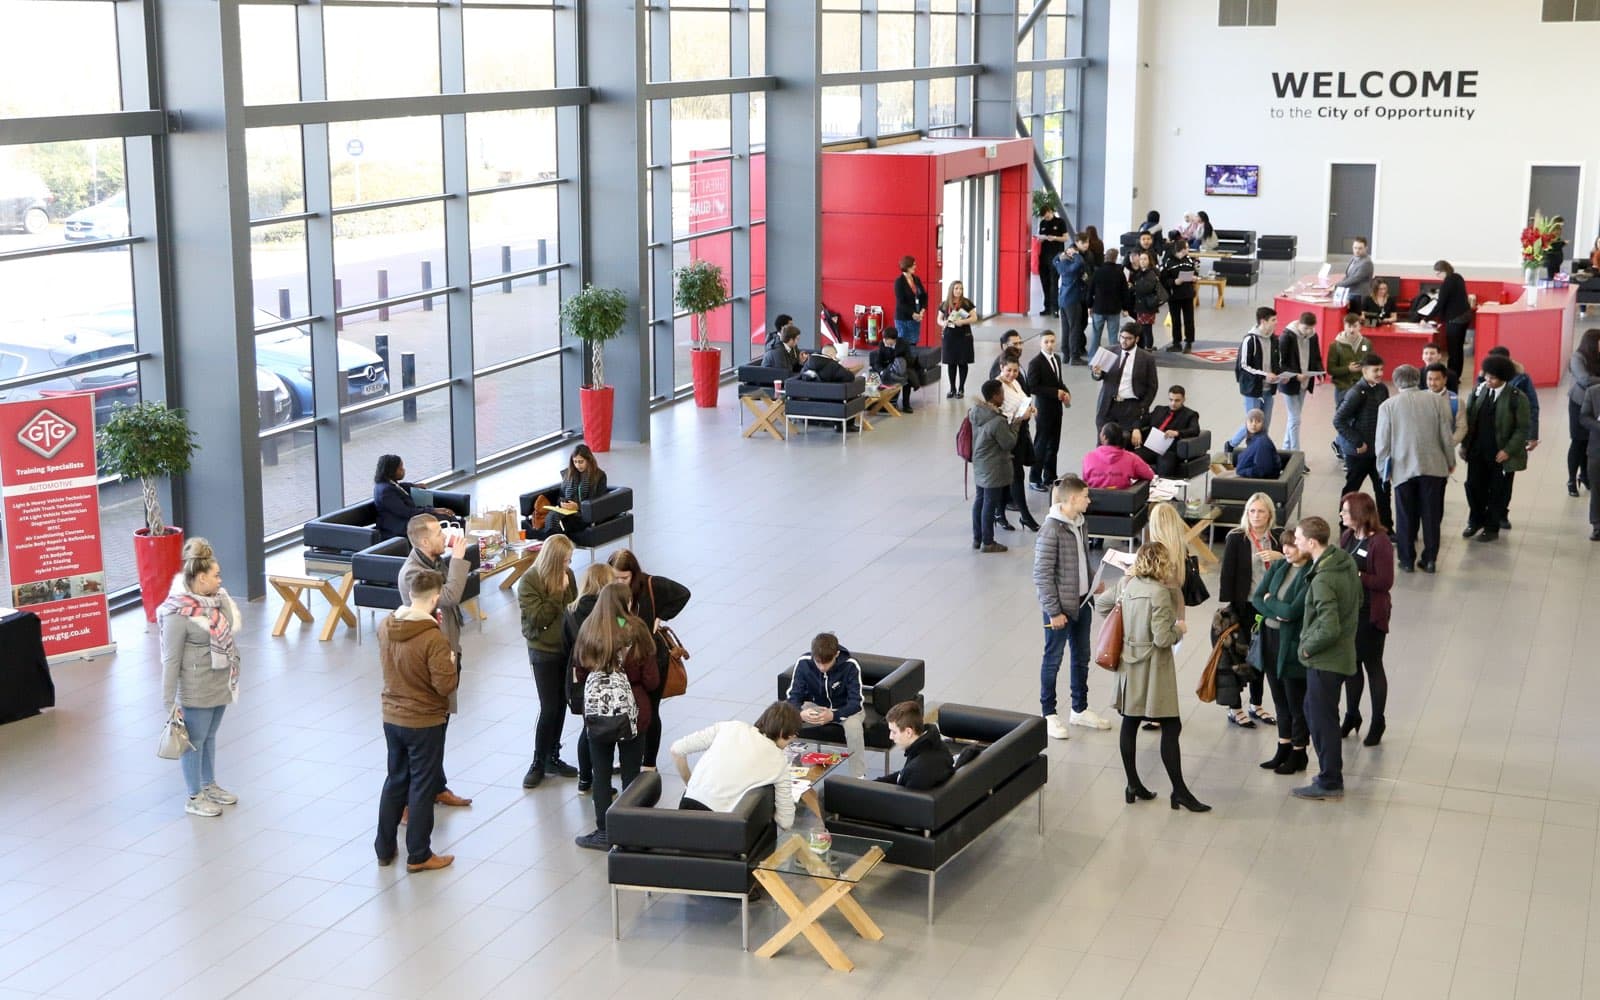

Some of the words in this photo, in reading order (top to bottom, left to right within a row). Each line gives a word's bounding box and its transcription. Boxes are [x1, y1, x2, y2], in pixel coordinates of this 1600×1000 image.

[1272, 71, 1478, 98] WELCOME
[1270, 107, 1284, 118] to
[1290, 107, 1312, 118] the
[1318, 106, 1348, 120] City
[1354, 106, 1370, 118] of
[1375, 106, 1475, 120] Opportunity
[28, 420, 66, 446] GTG
[16, 467, 46, 476] Training
[46, 462, 84, 472] Specialists
[29, 480, 72, 491] AUTOMOTIVE
